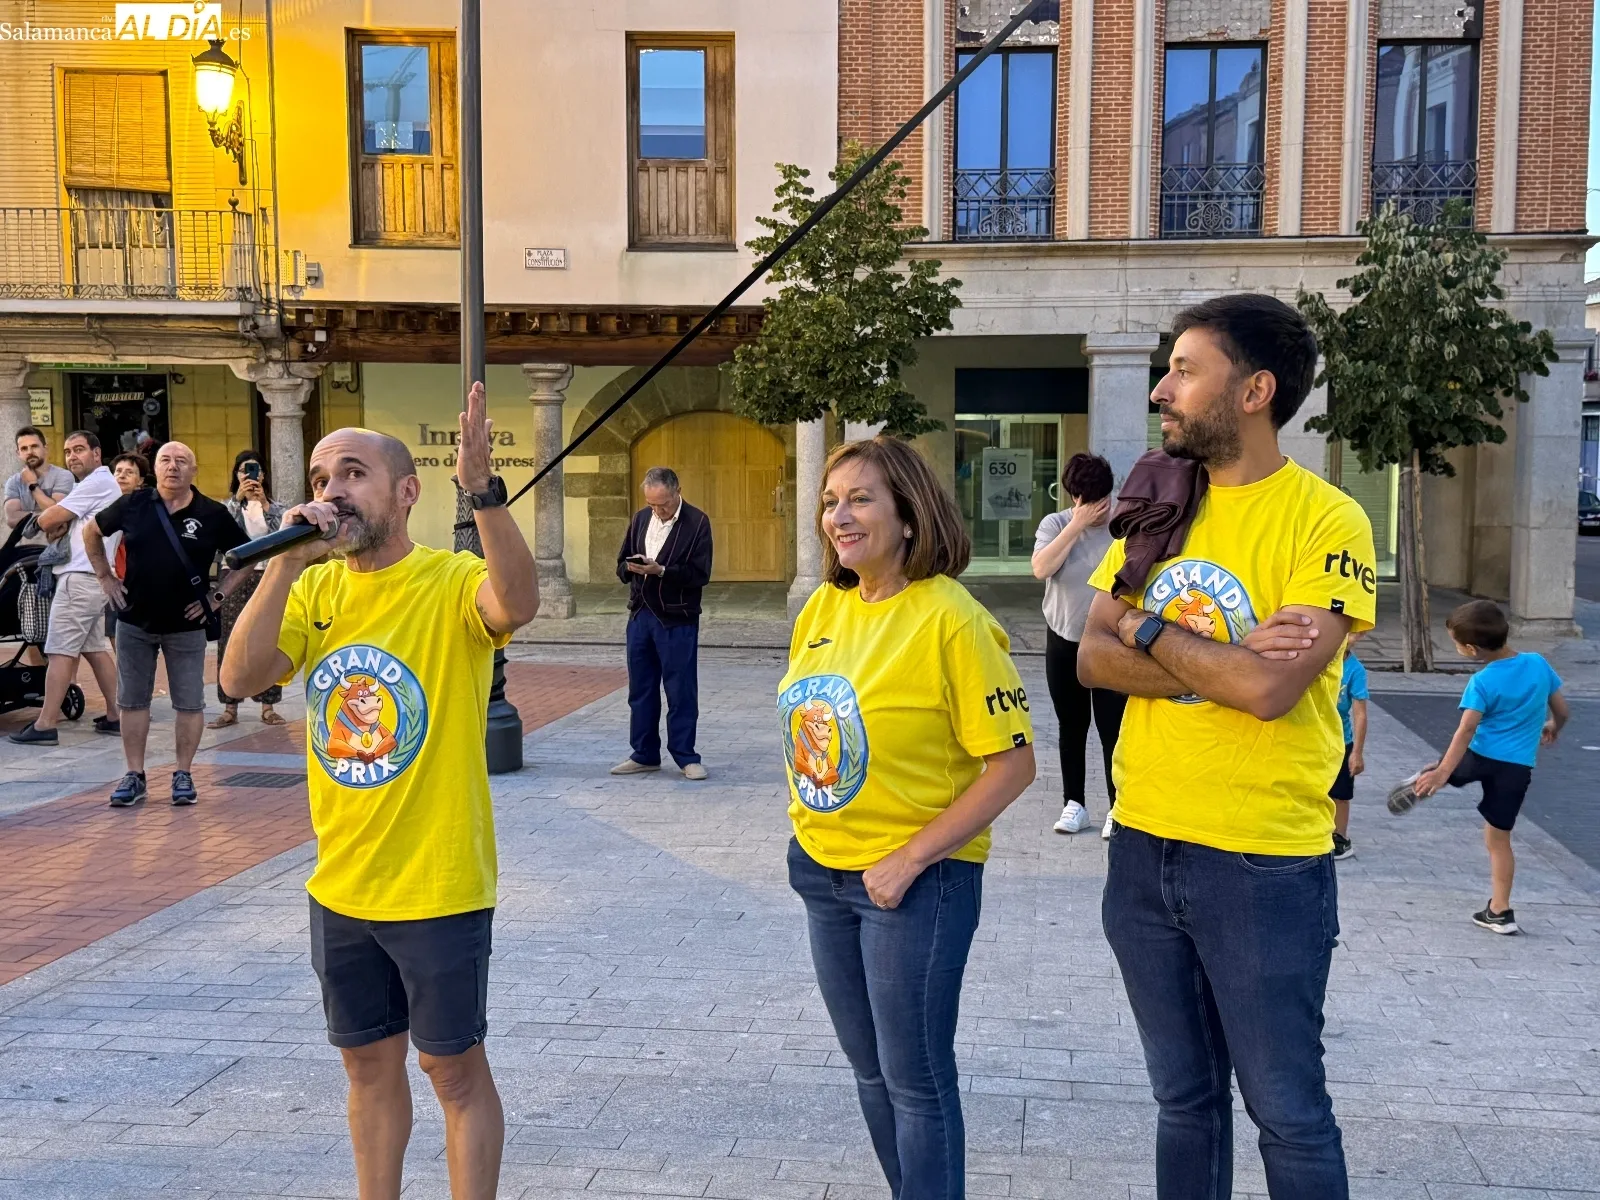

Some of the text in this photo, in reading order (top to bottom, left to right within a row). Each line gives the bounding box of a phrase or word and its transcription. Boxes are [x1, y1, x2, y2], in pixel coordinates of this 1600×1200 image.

[527, 257, 563, 267] CONSTITUCIÓN
[418, 423, 516, 446] Innva
[989, 462, 1017, 475] 630
[1152, 563, 1242, 610] GRAND
[1324, 549, 1376, 595] rtve
[313, 648, 402, 691] GRAND
[786, 678, 854, 718] GRAND
[985, 686, 1030, 716] rtve
[334, 754, 399, 784] PRIX
[799, 776, 841, 807] PRIX
